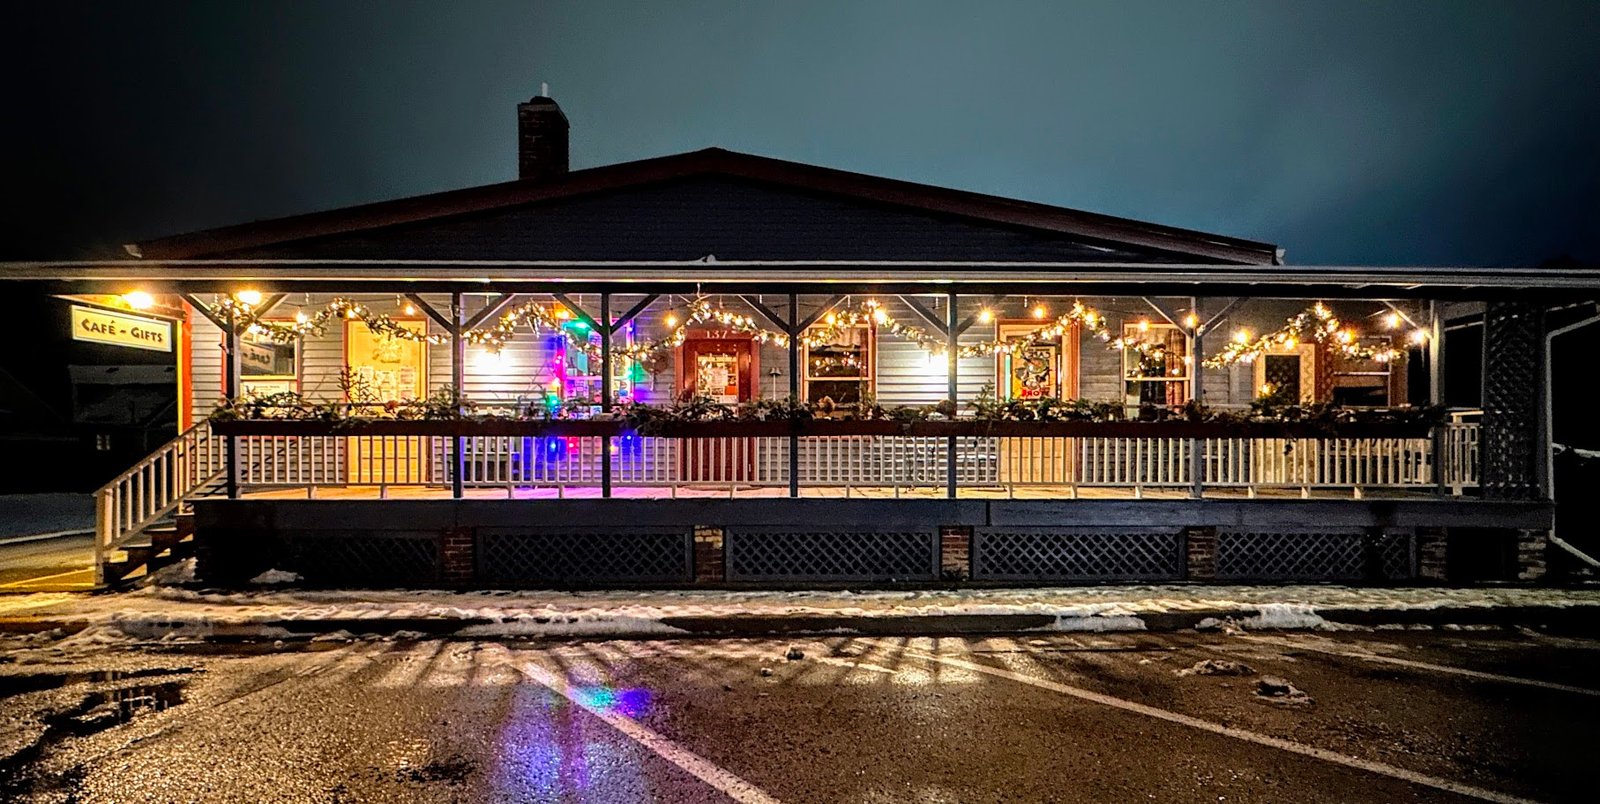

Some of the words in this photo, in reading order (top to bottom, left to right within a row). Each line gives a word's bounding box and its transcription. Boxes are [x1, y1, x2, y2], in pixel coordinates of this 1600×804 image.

[81, 318, 116, 335] CAFÉ
[130, 326, 163, 342] GIFTS
[706, 330, 728, 339] 137
